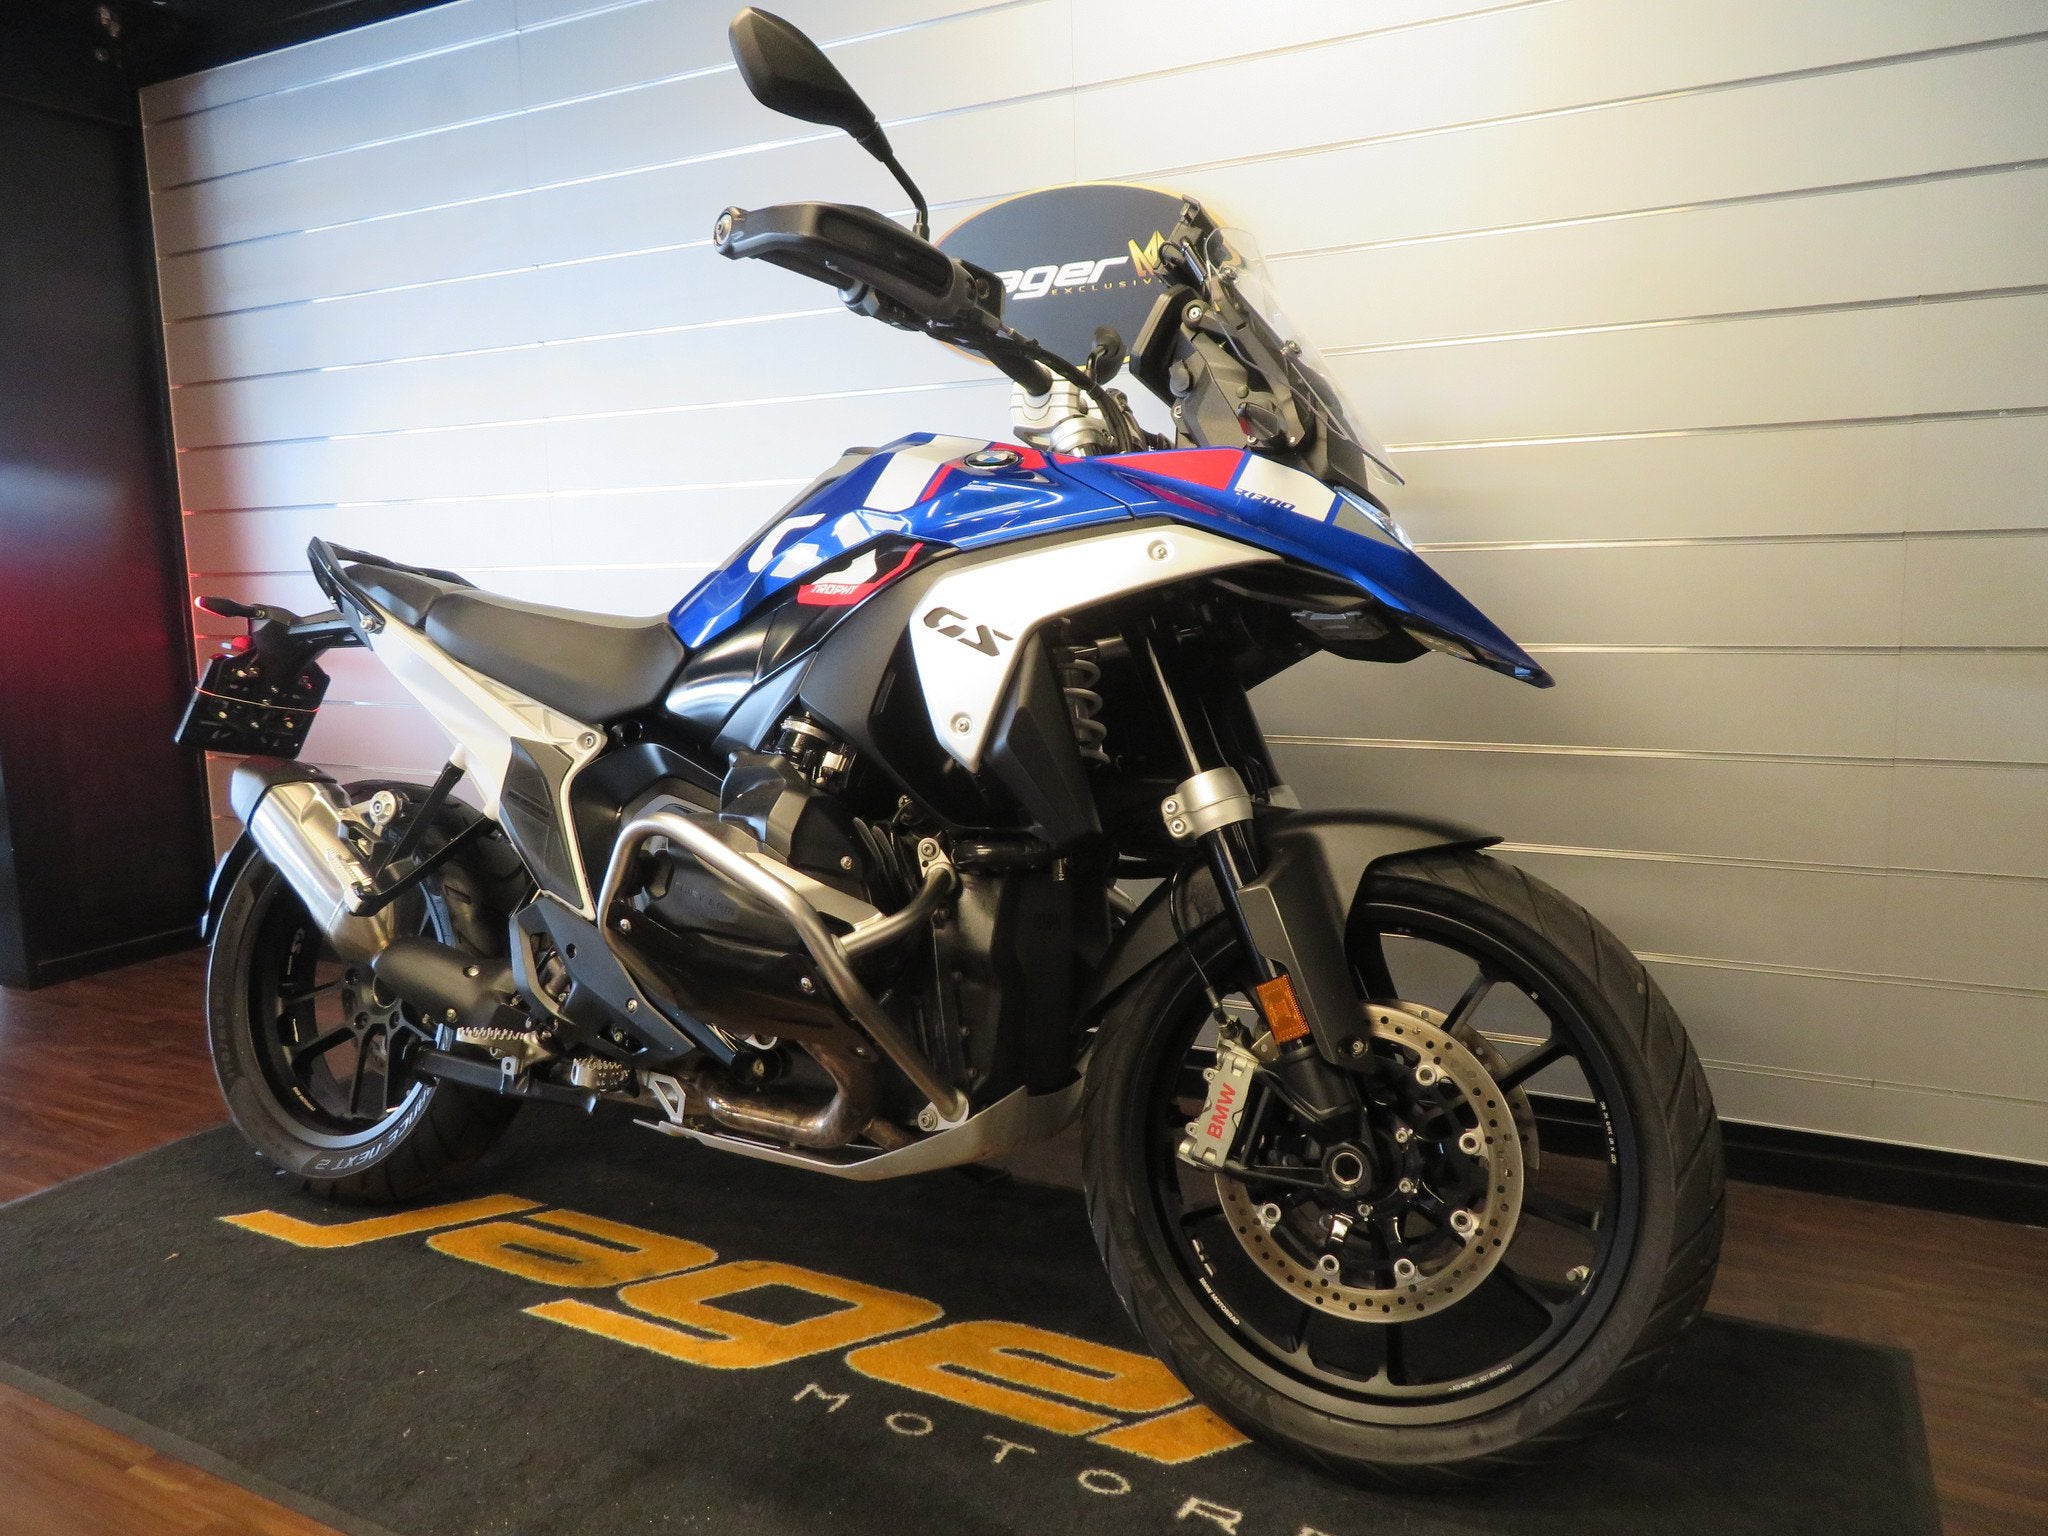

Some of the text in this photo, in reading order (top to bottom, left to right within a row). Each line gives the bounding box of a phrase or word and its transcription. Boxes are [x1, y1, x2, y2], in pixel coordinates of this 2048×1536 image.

[993, 255, 1129, 300] ager
[1051, 278, 1164, 296] EXCLUSIV
[811, 583, 860, 595] TROPHY
[923, 606, 1014, 657] GS
[1206, 1082, 1236, 1140] BMW
[793, 1383, 1335, 1536] MOTOR
